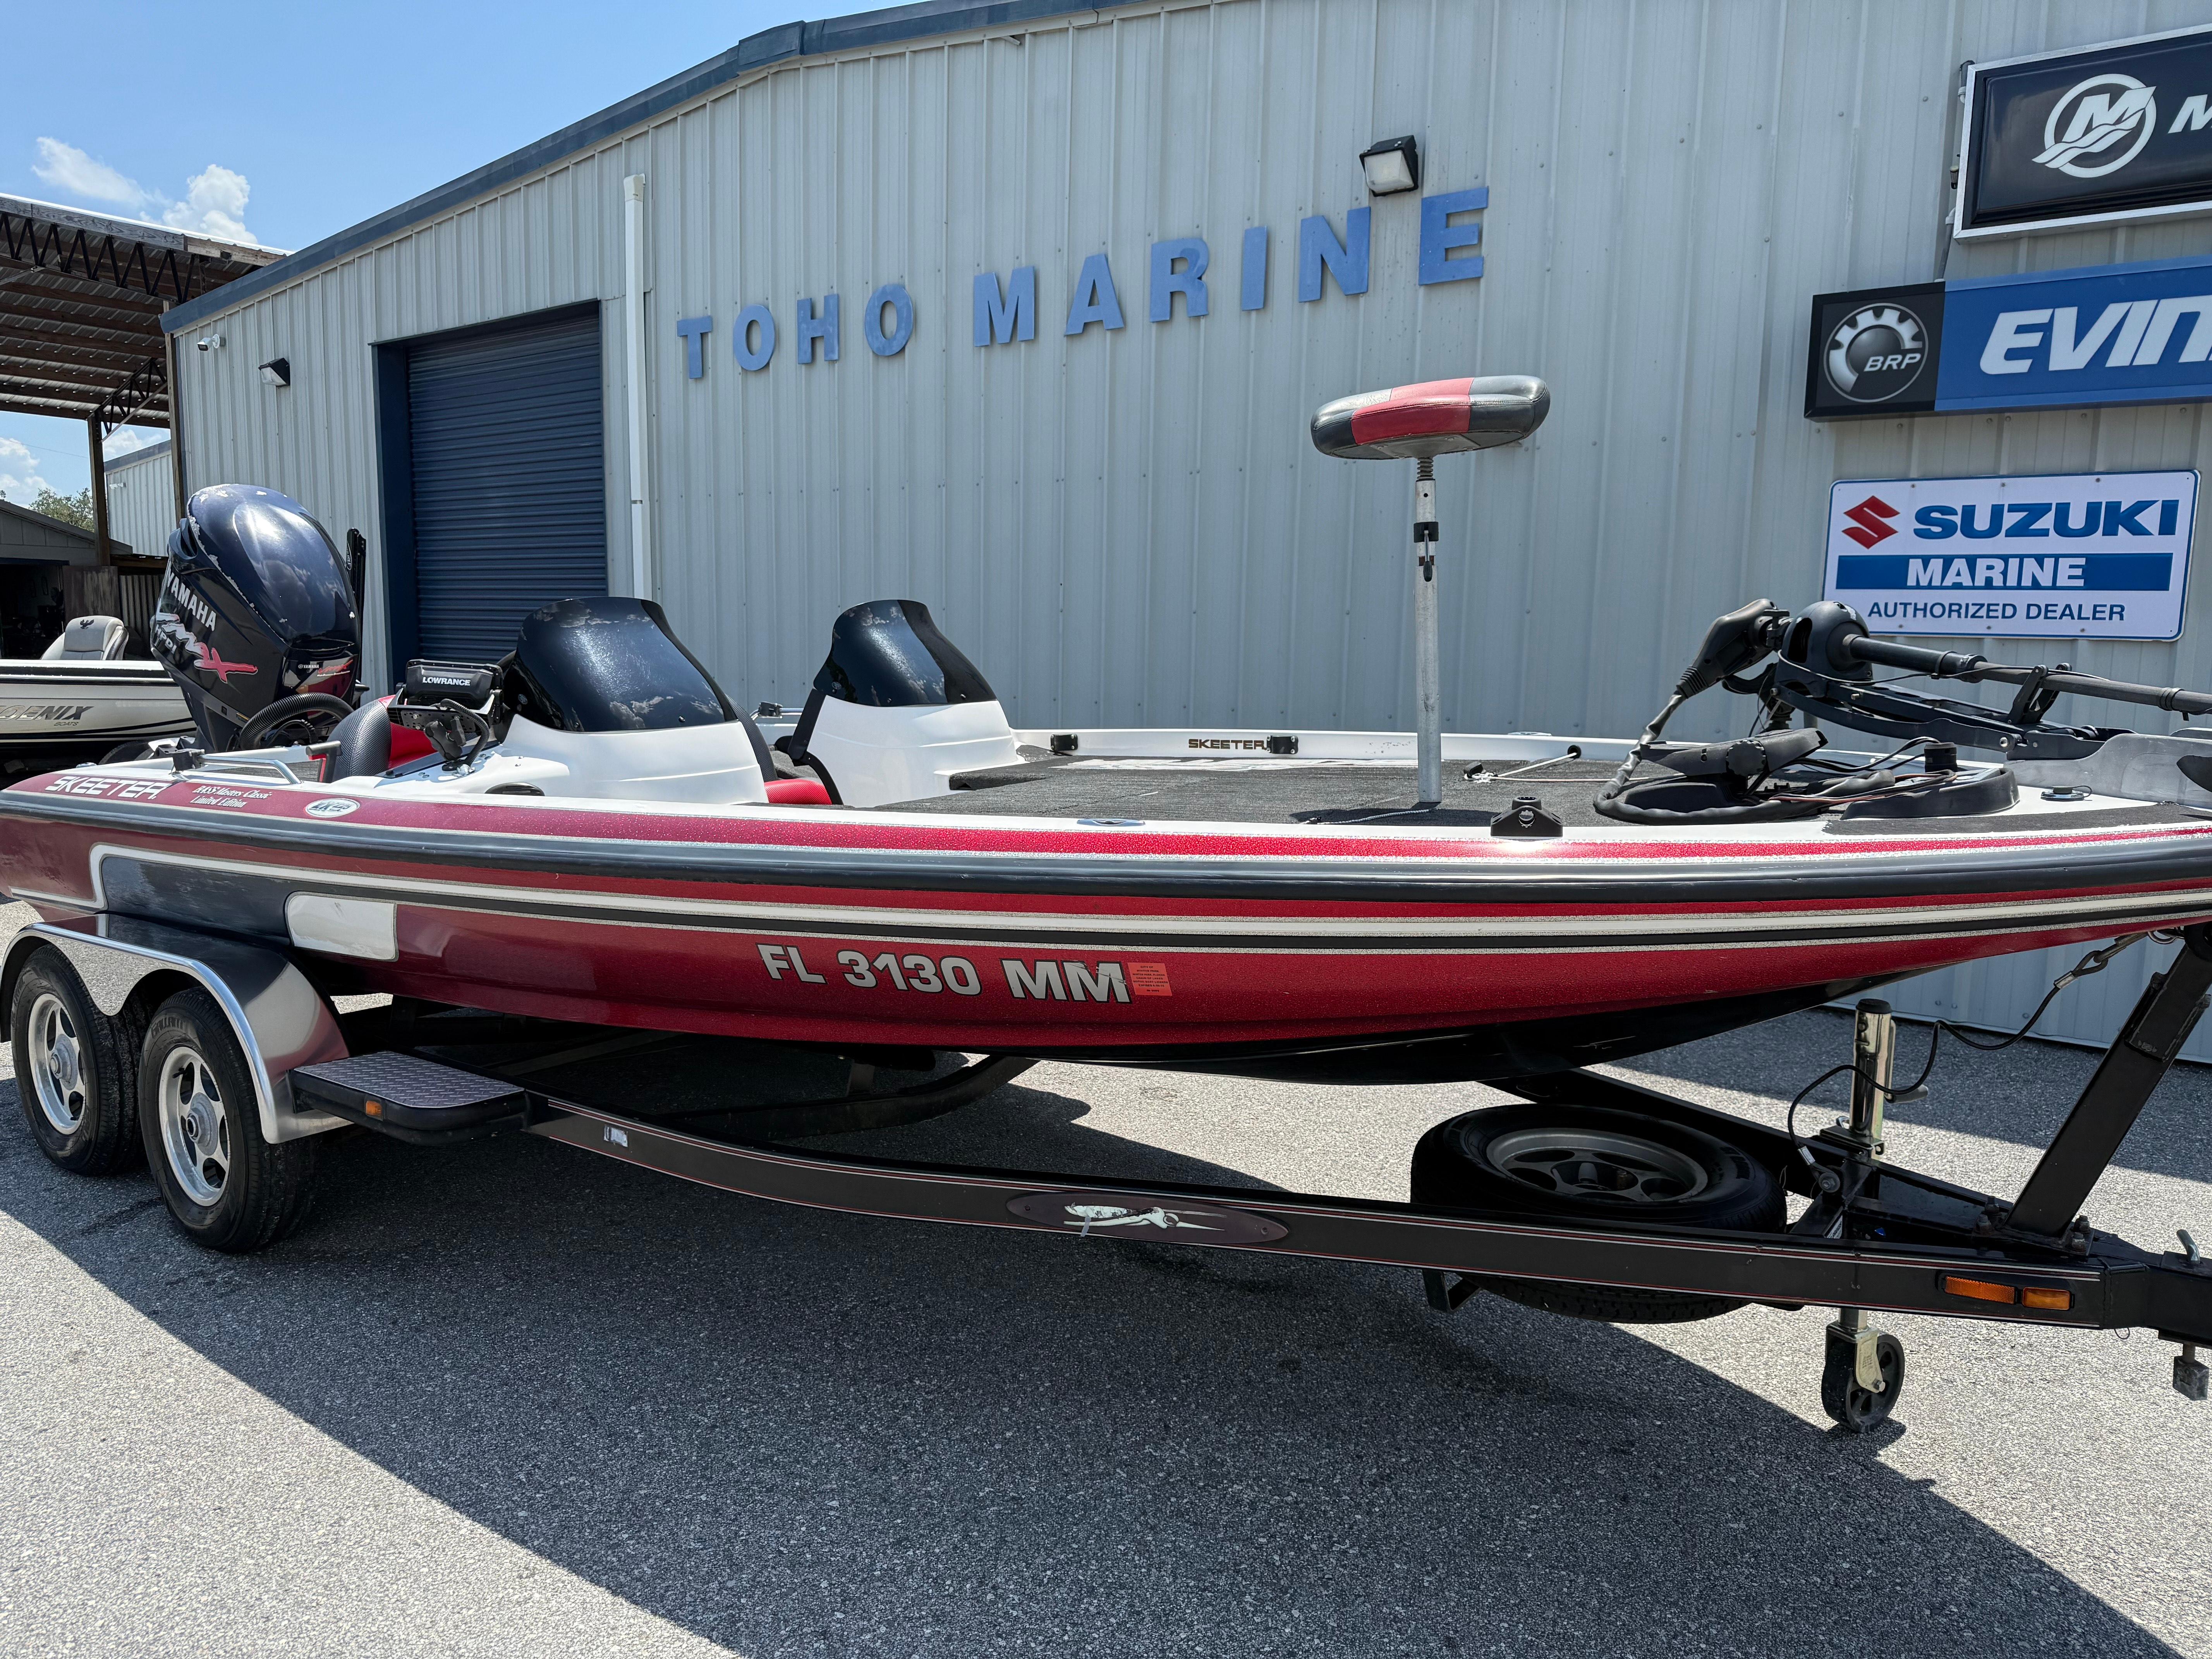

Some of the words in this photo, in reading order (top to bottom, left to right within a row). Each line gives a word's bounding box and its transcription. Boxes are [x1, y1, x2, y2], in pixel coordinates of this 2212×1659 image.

[677, 284, 914, 380] TOHO
[973, 186, 1489, 347] MARINE
[1980, 295, 2212, 374] EVIN
[1864, 352, 1921, 372] BRP
[1913, 500, 2180, 539] SUZUKI
[1906, 557, 2087, 587] MARINE
[167, 567, 216, 632] YAMAHA
[1868, 602, 2017, 620] AUTHORIZED
[2026, 603, 2125, 621] DEALER
[422, 677, 471, 686] LOWRANCE
[0, 705, 94, 720] OENIX
[1188, 739, 1267, 750] SKEETER
[45, 776, 172, 799] SKEETER
[189, 795, 222, 805] Limited
[217, 797, 247, 808] Edition
[756, 943, 826, 984] FL
[836, 948, 983, 996] 3130
[1000, 958, 1132, 1004] MM
